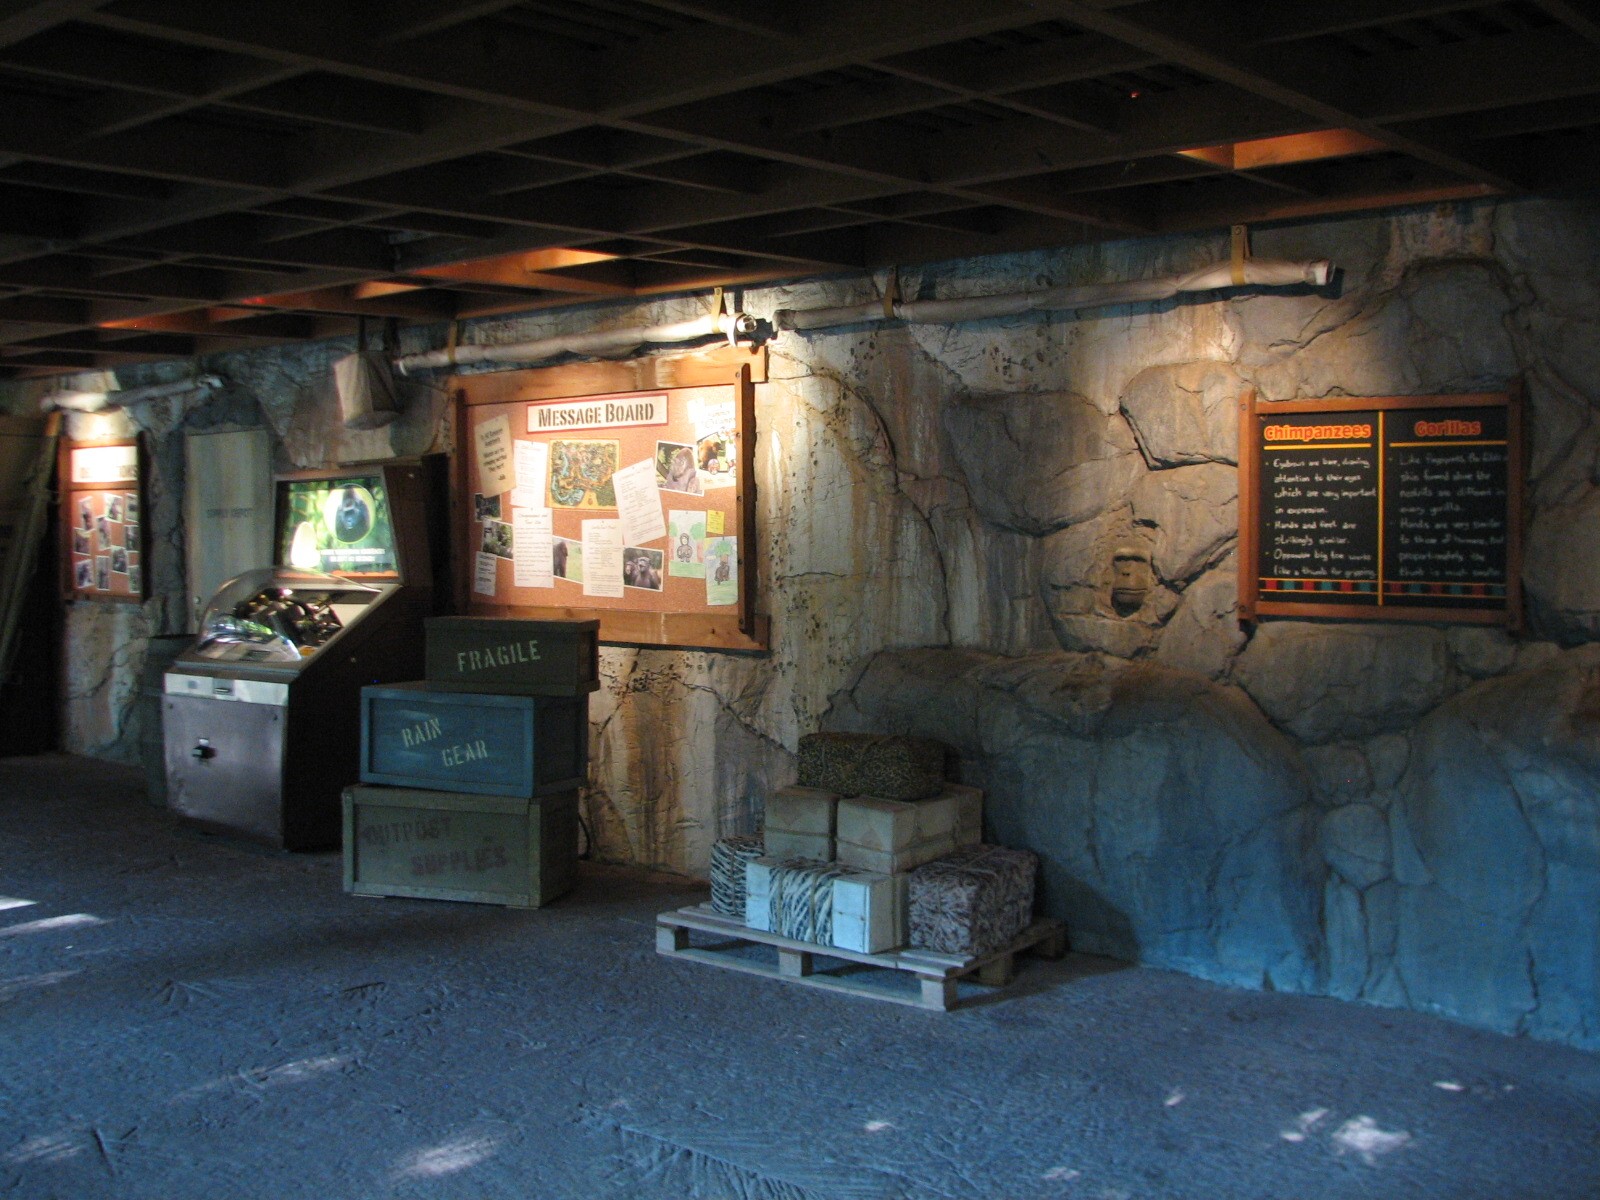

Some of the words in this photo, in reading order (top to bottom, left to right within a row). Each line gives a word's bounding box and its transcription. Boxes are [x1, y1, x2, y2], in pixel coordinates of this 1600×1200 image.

[538, 406, 602, 428] MESSAGE
[605, 402, 655, 423] BOARD
[1264, 424, 1372, 442] Chimpanzees
[1414, 420, 1482, 437] Gorillas
[1274, 473, 1310, 483] attention
[1314, 473, 1324, 482] to
[1274, 486, 1302, 498] which
[1322, 490, 1340, 501] very
[1341, 487, 1377, 499] important
[1274, 505, 1284, 514] in
[1302, 521, 1317, 530] and
[1314, 549, 1329, 562] big
[457, 640, 541, 672] FRAGILE
[401, 717, 441, 748] RAIN
[441, 739, 489, 768] GEAR
